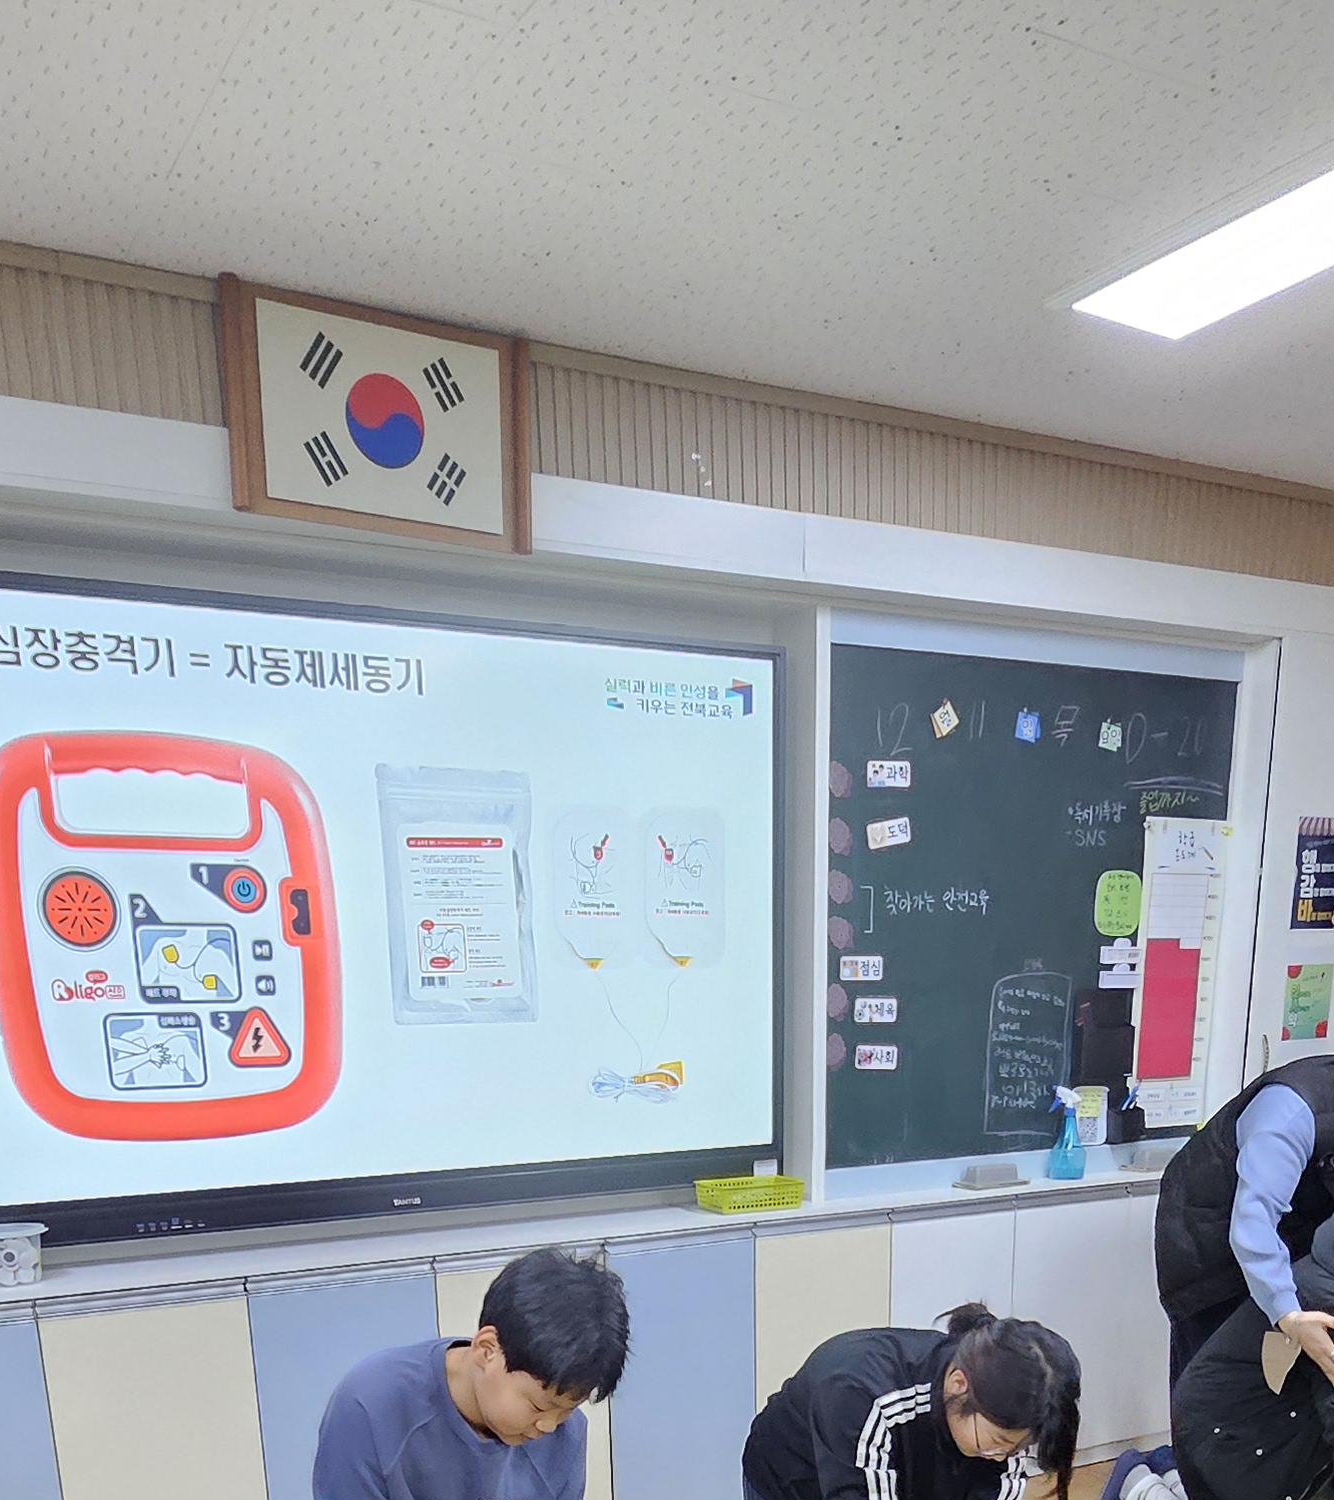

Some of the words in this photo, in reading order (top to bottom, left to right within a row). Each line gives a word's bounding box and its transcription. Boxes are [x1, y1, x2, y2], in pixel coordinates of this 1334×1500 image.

[223, 642, 426, 696] 자동제세동기
[604, 677, 645, 695] 실력과
[636, 698, 677, 716] 키우는
[680, 701, 734, 720] 전북교육
[876, 701, 914, 758] 12
[1051, 704, 1081, 748] 목
[885, 765, 909, 783] 과학
[887, 821, 909, 839] 도덕
[1074, 828, 1108, 847] SNS
[198, 865, 209, 885] 1
[132, 899, 148, 919] 2
[883, 886, 936, 916] 찾아가는
[942, 886, 990, 916] 안전교육
[859, 959, 881, 978] 점심
[874, 1002, 896, 1018] 체육
[217, 1014, 232, 1031] 3
[873, 1048, 895, 1064] 사회
